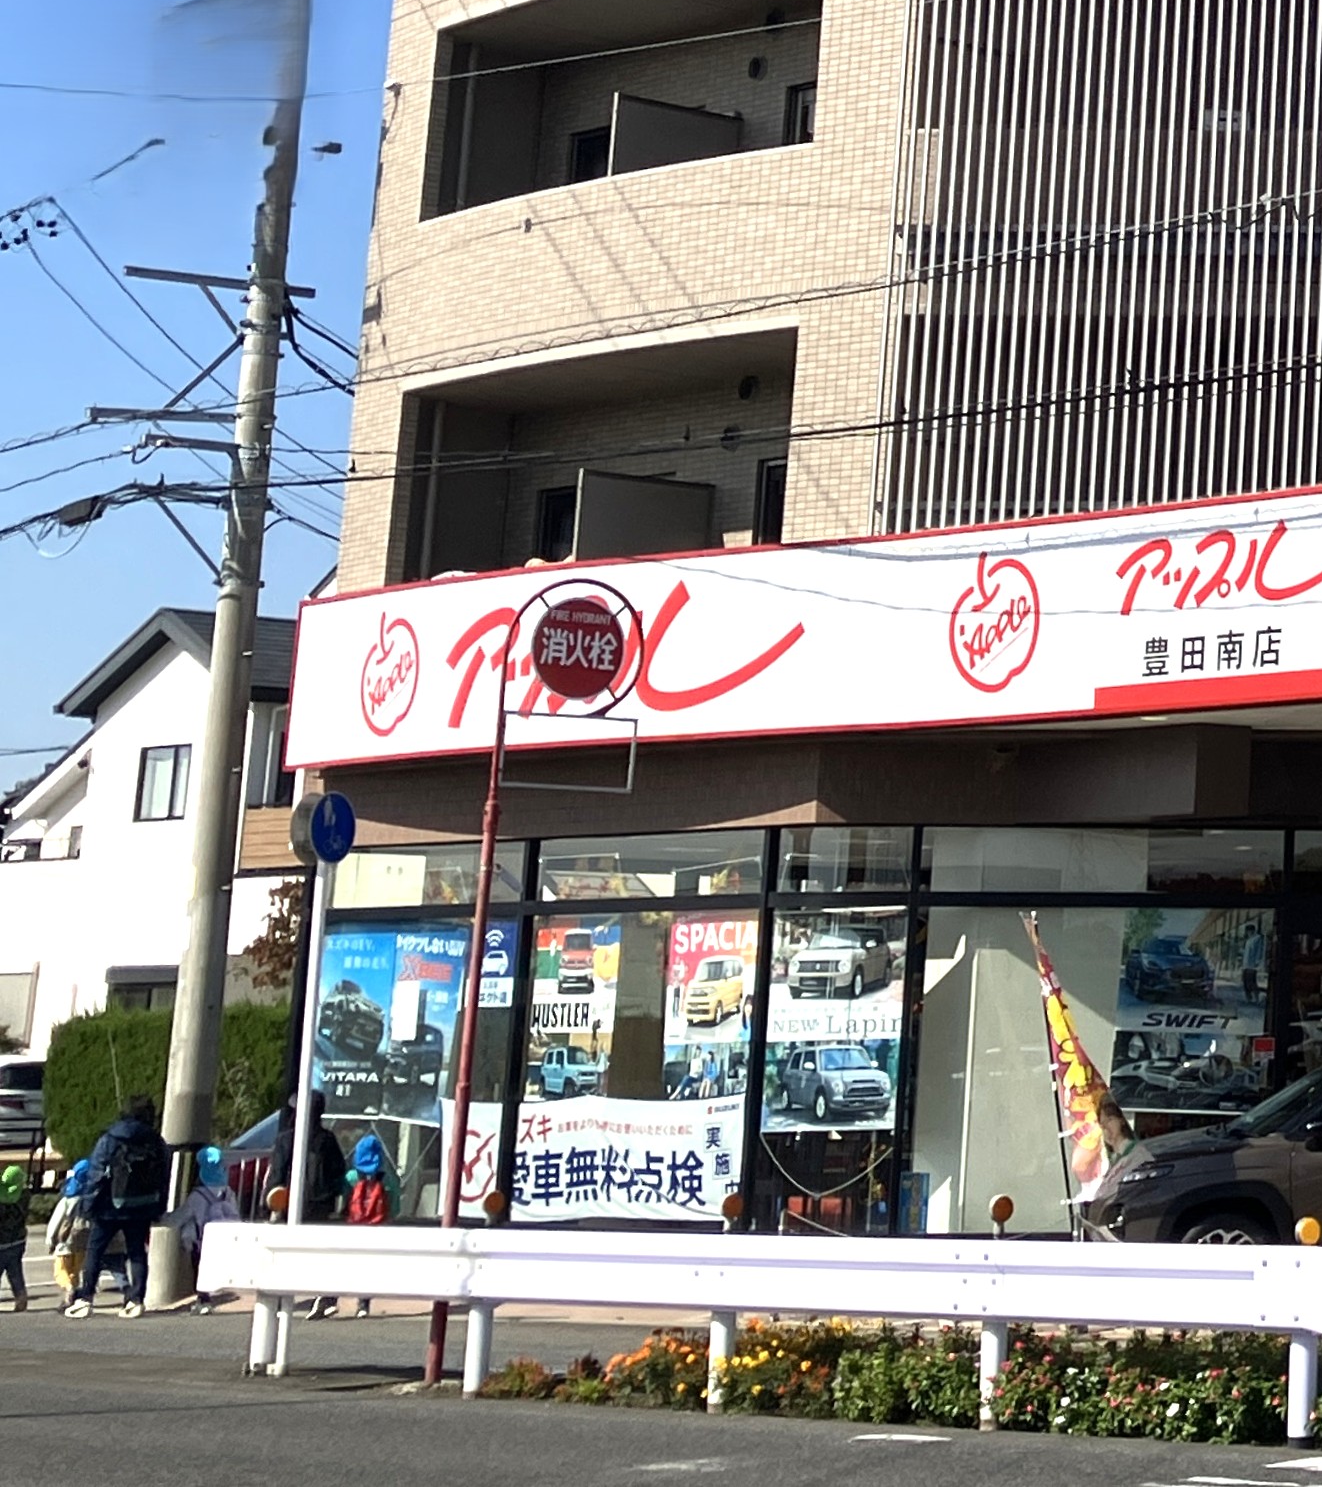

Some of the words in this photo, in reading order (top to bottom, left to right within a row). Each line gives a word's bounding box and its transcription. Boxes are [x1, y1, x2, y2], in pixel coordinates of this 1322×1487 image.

[550, 609, 570, 622] FIRE
[571, 611, 611, 626] HYDRANT
[539, 626, 618, 671] 消火栓
[1141, 626, 1283, 676] 豊田南店
[675, 920, 757, 954] SPACIA
[532, 1002, 590, 1029] HUSTLER
[1142, 1011, 1239, 1030] SWIFT
[319, 1071, 380, 1083] VITARA
